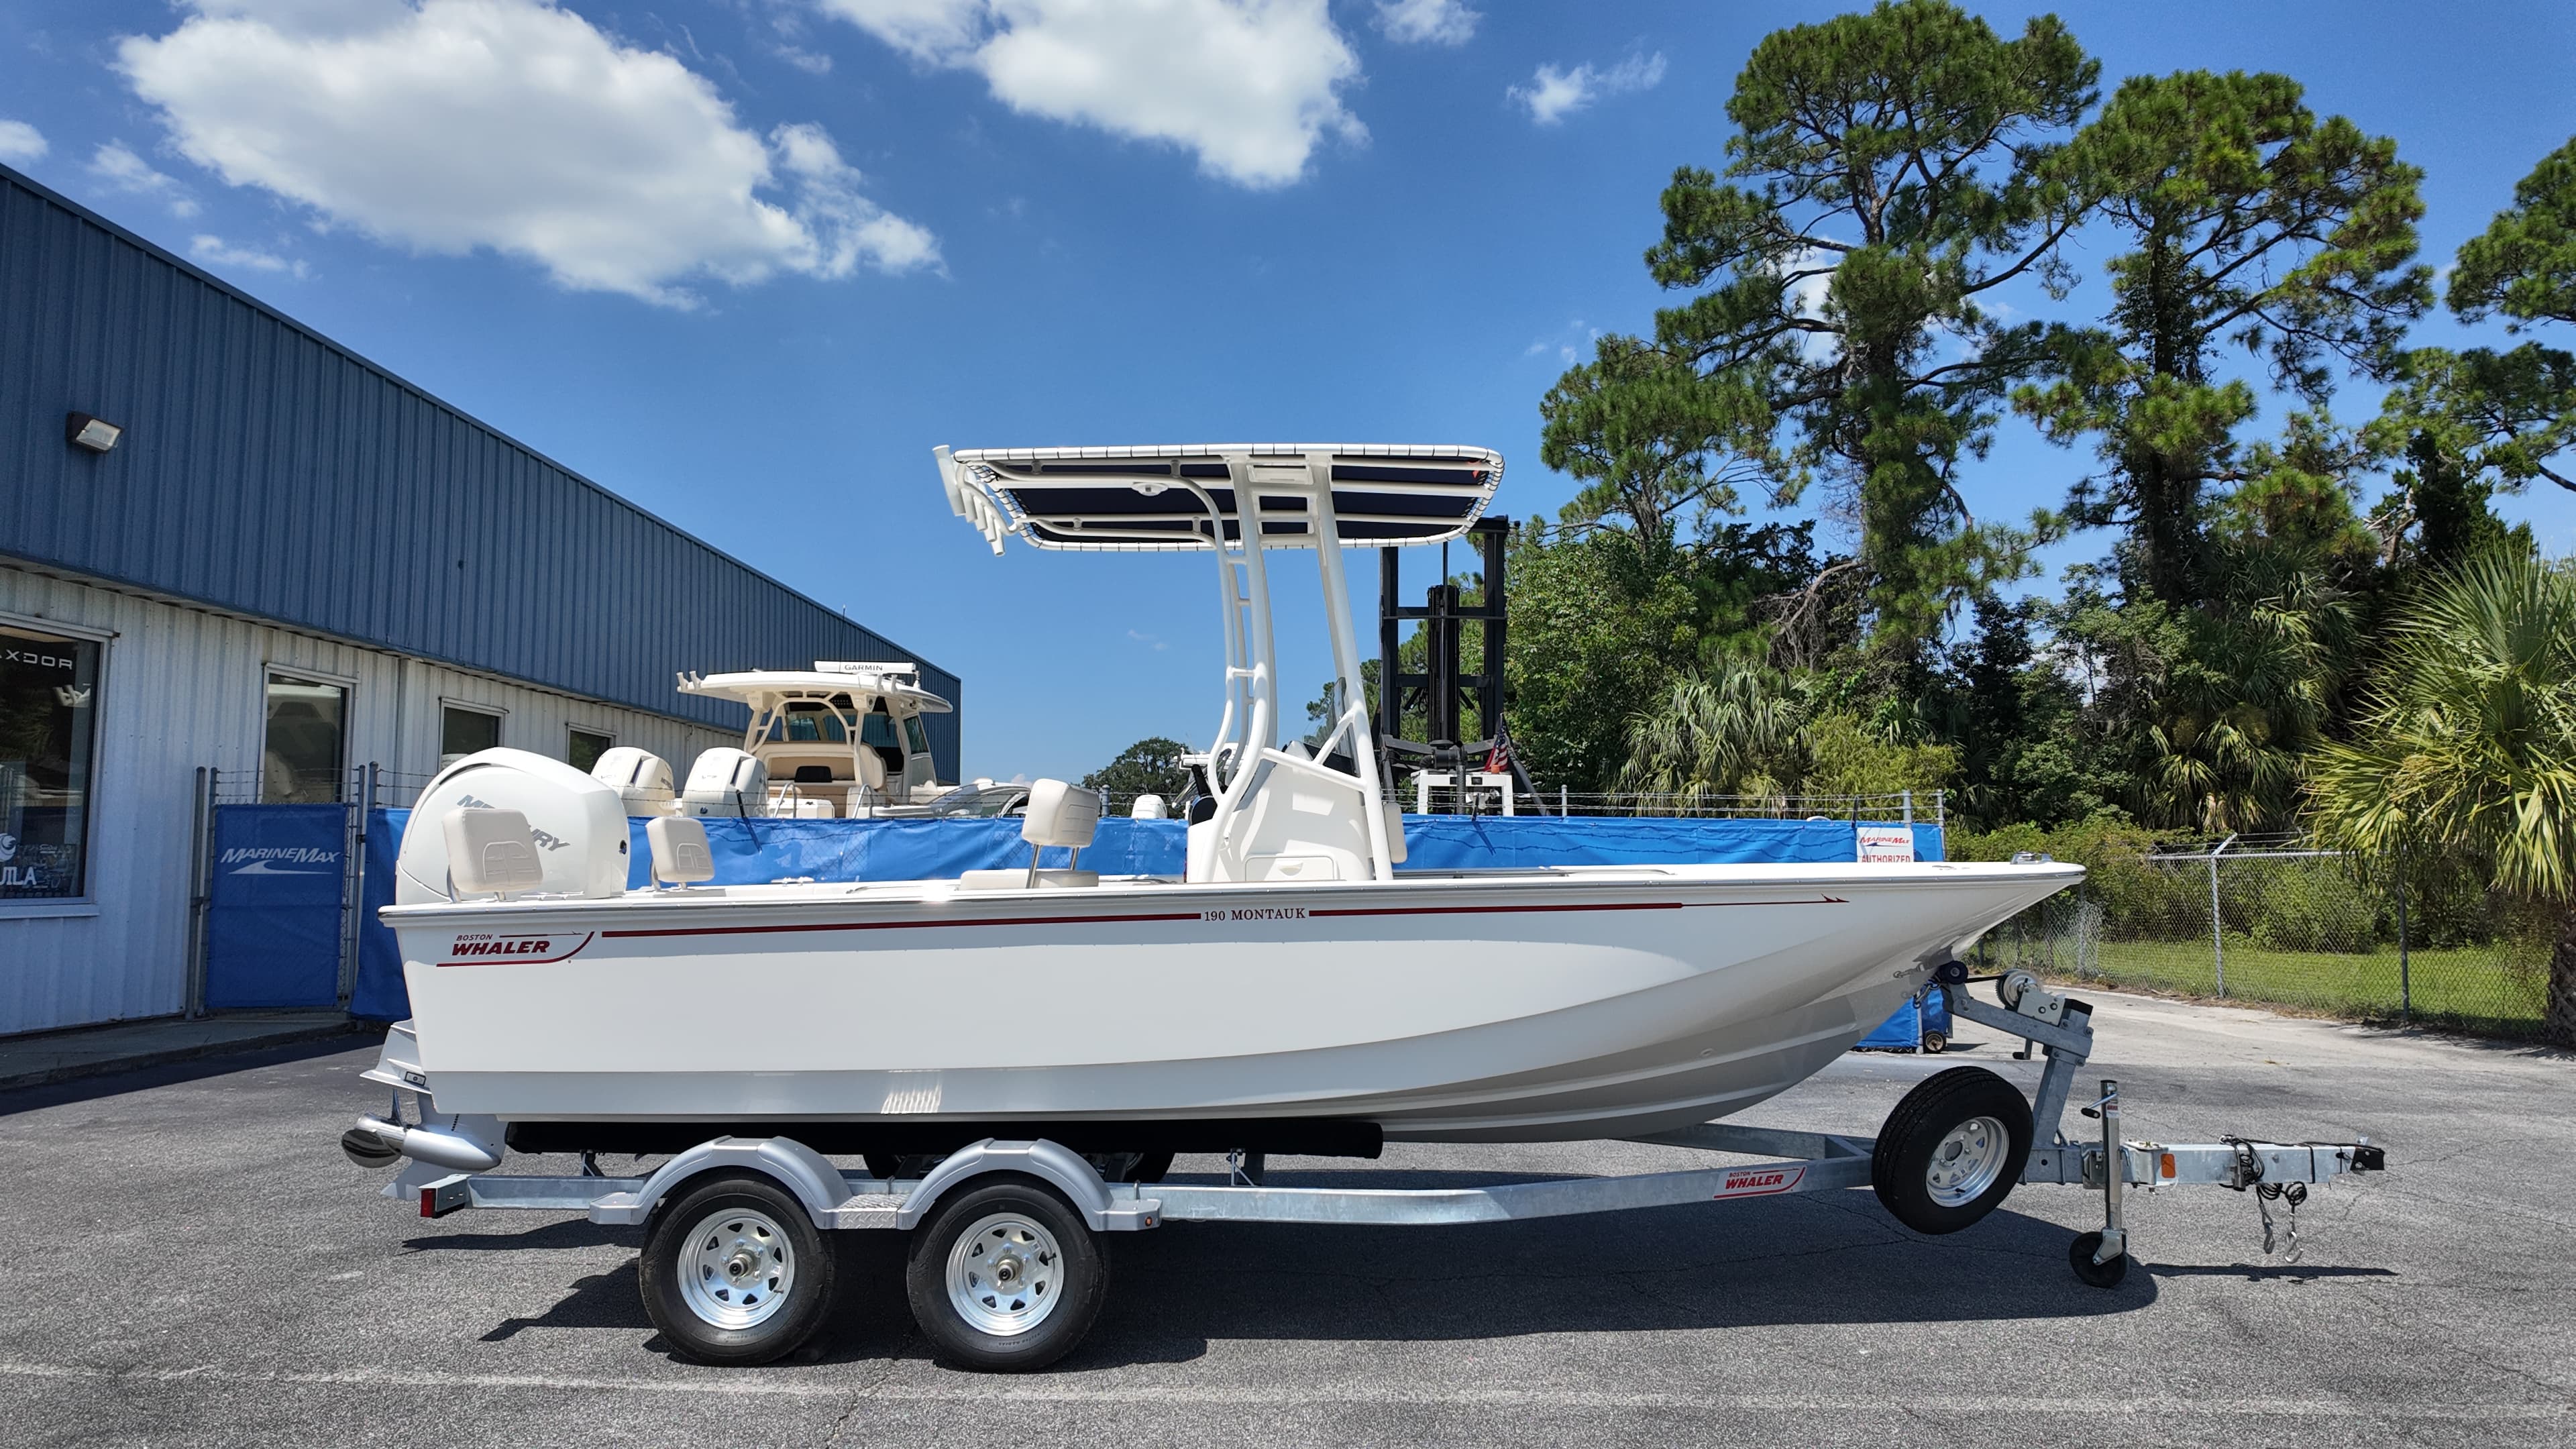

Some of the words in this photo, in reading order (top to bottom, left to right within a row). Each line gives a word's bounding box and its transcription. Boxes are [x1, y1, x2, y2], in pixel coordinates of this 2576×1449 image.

[0, 649, 72, 670] XDOR
[1204, 910, 1226, 922] 190
[1230, 908, 1306, 921] MONTAUK
[455, 934, 493, 942] BOSTON
[451, 941, 550, 956] WHALER
[1725, 1174, 1784, 1190] WHALER
